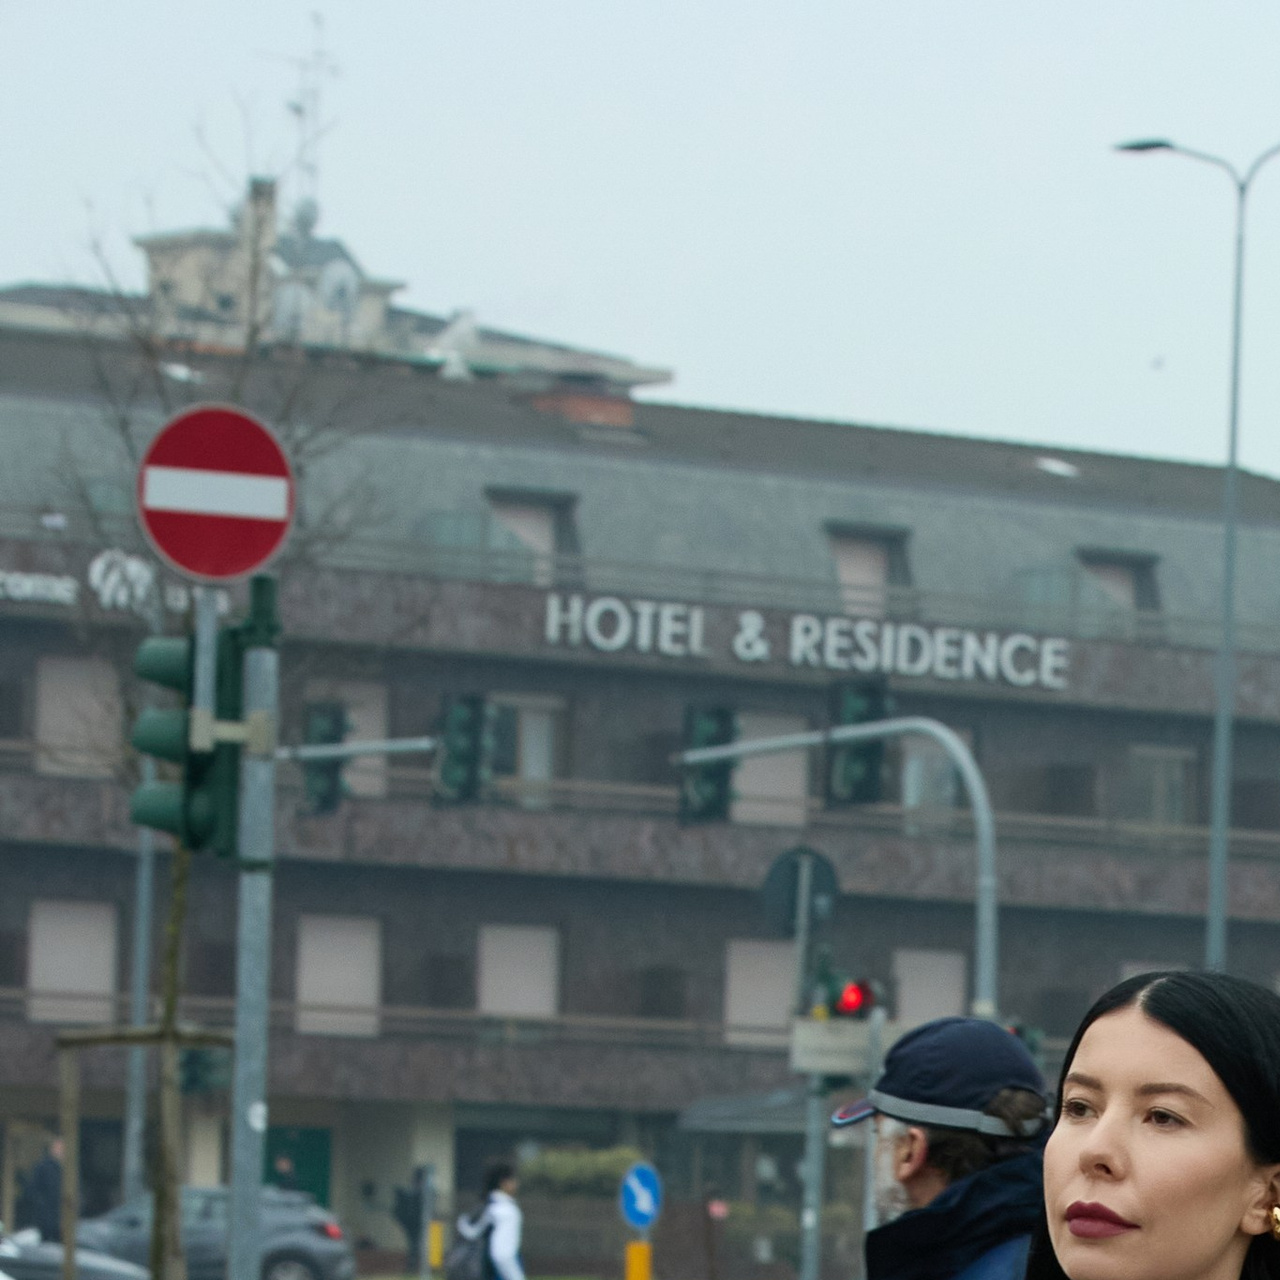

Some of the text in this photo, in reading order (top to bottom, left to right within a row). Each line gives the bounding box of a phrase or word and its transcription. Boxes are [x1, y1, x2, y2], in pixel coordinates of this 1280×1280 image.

[545, 594, 1069, 690] HOTEL & RESIDENCE
